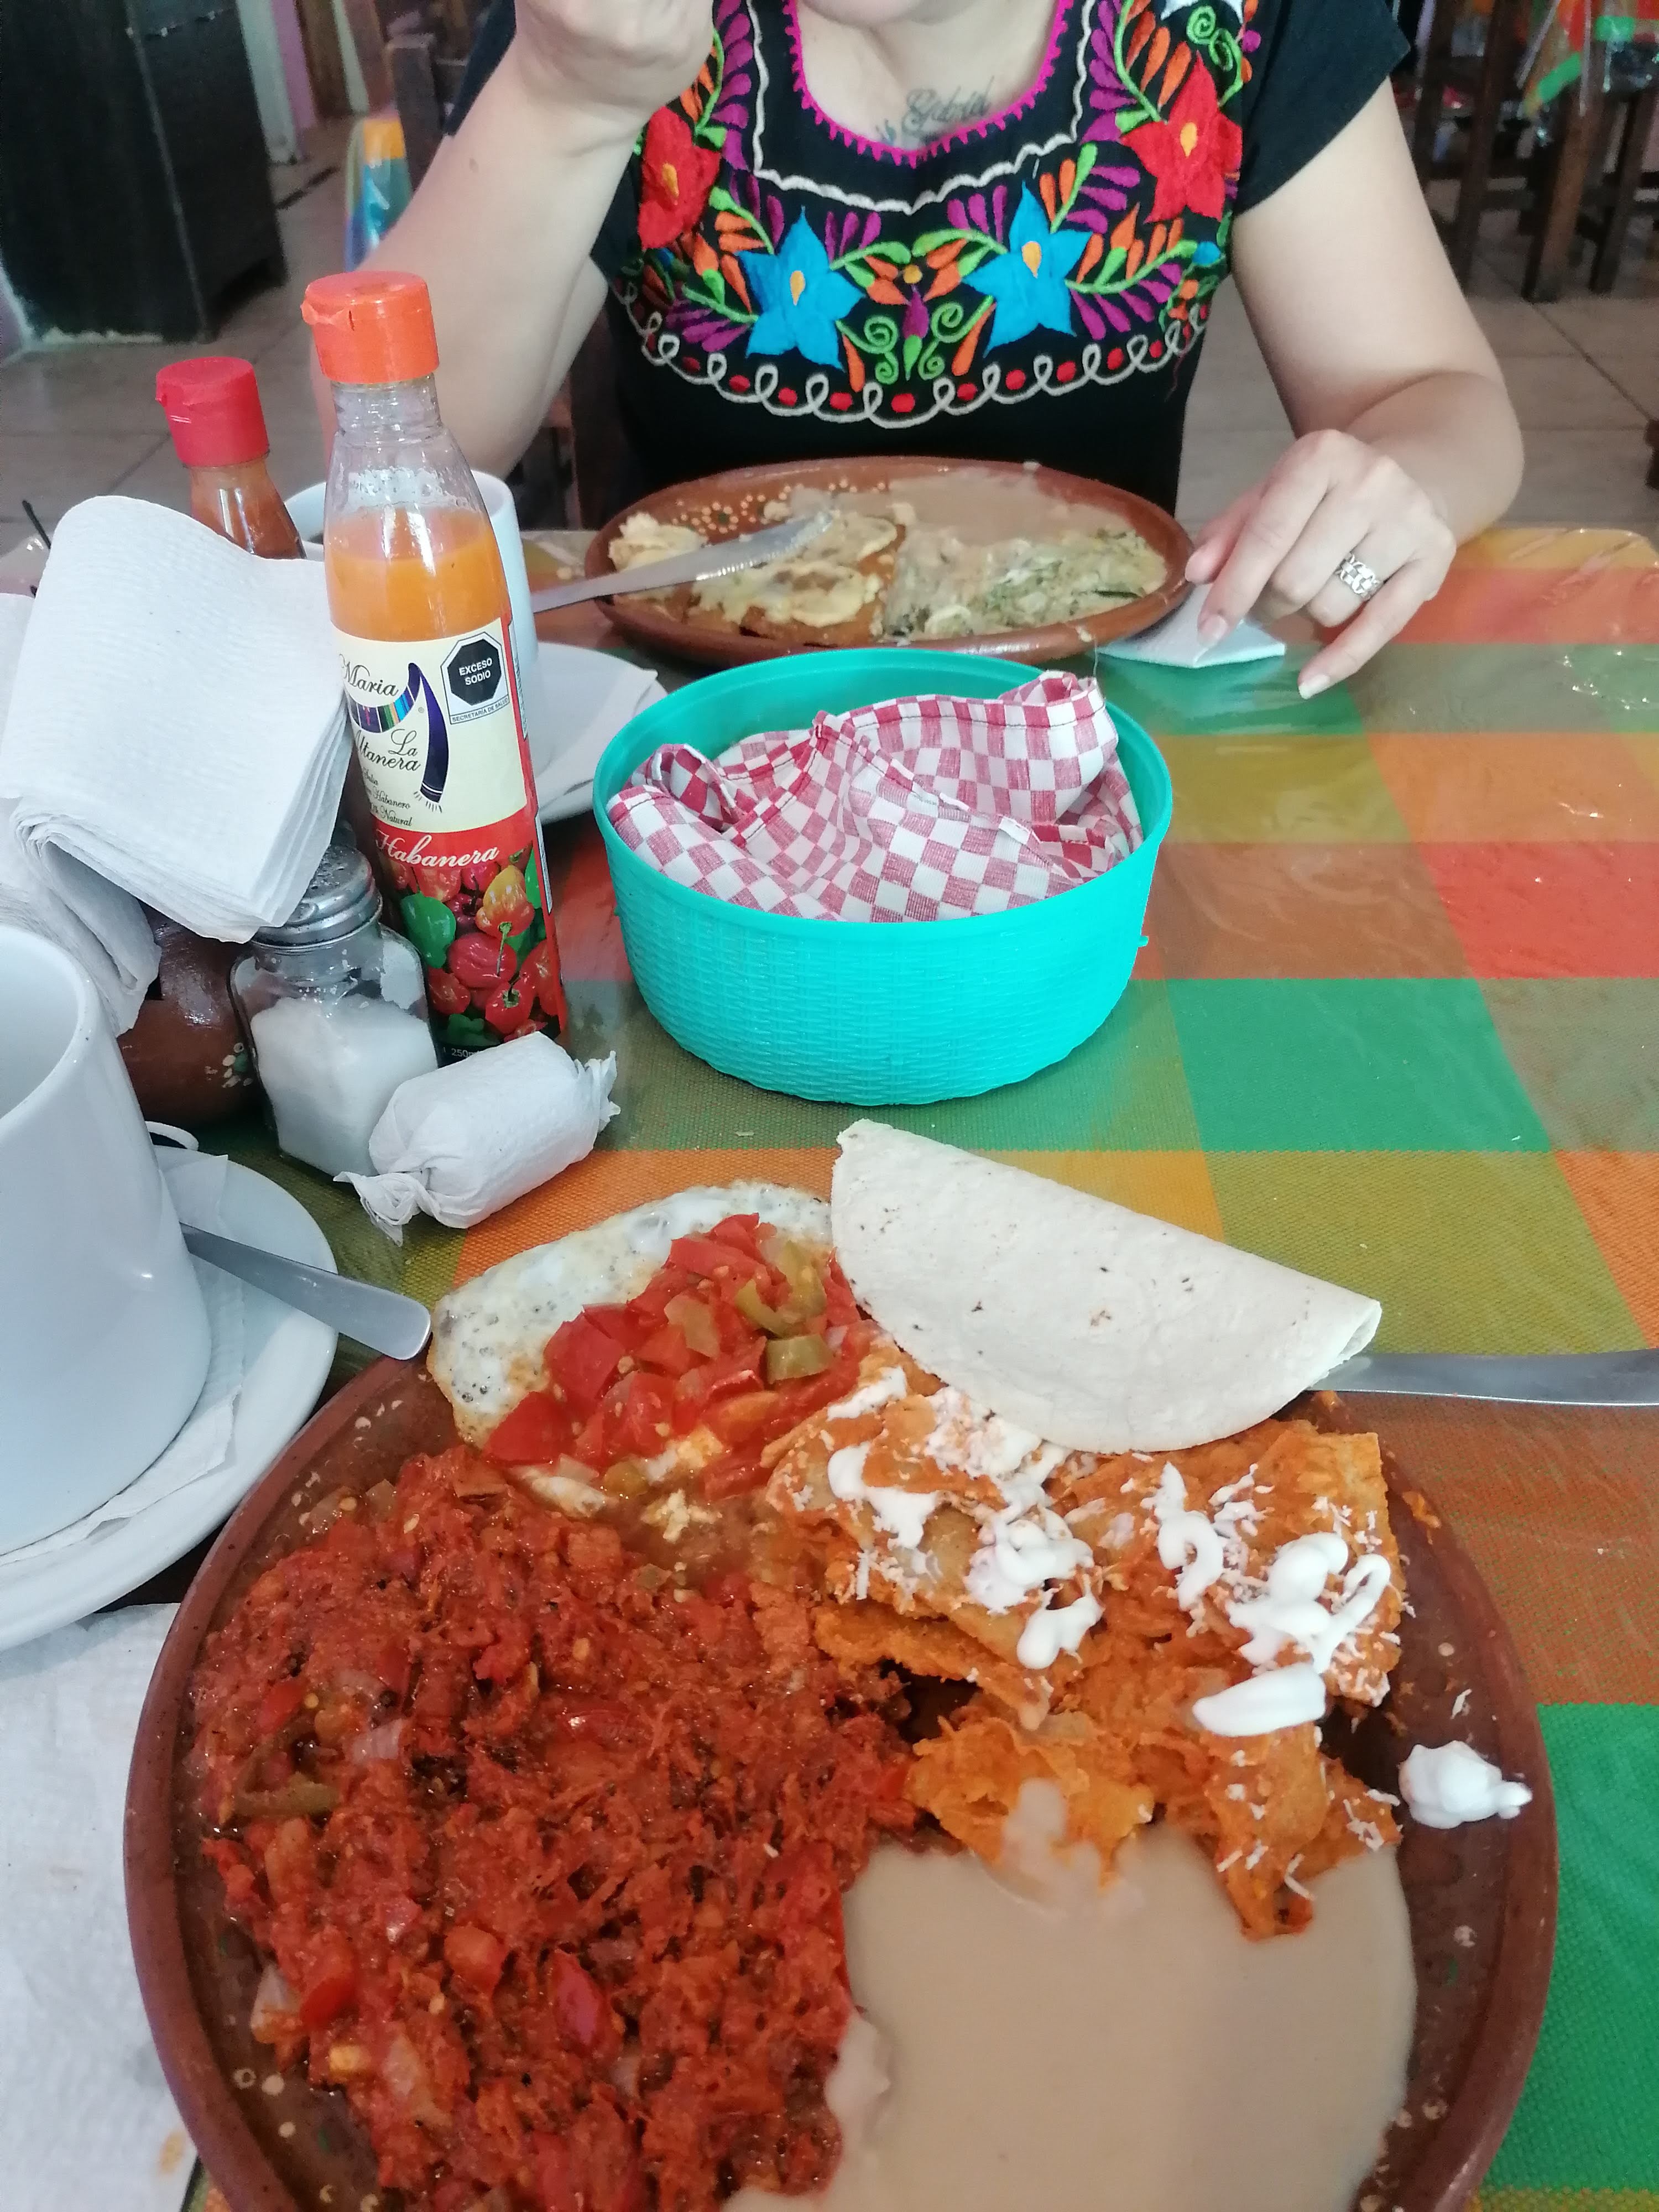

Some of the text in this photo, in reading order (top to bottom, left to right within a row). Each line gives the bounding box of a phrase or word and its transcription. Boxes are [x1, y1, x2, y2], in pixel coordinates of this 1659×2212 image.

[339, 654, 399, 696] Maria
[458, 657, 493, 676] EXCESO
[464, 670, 491, 686] SODIO
[452, 708, 487, 722] SECRETARÍA
[495, 697, 509, 709] SALUD
[388, 729, 418, 757] La
[373, 786, 410, 809] Habanero
[380, 805, 413, 826] Natural
[376, 829, 499, 867] Habanera
